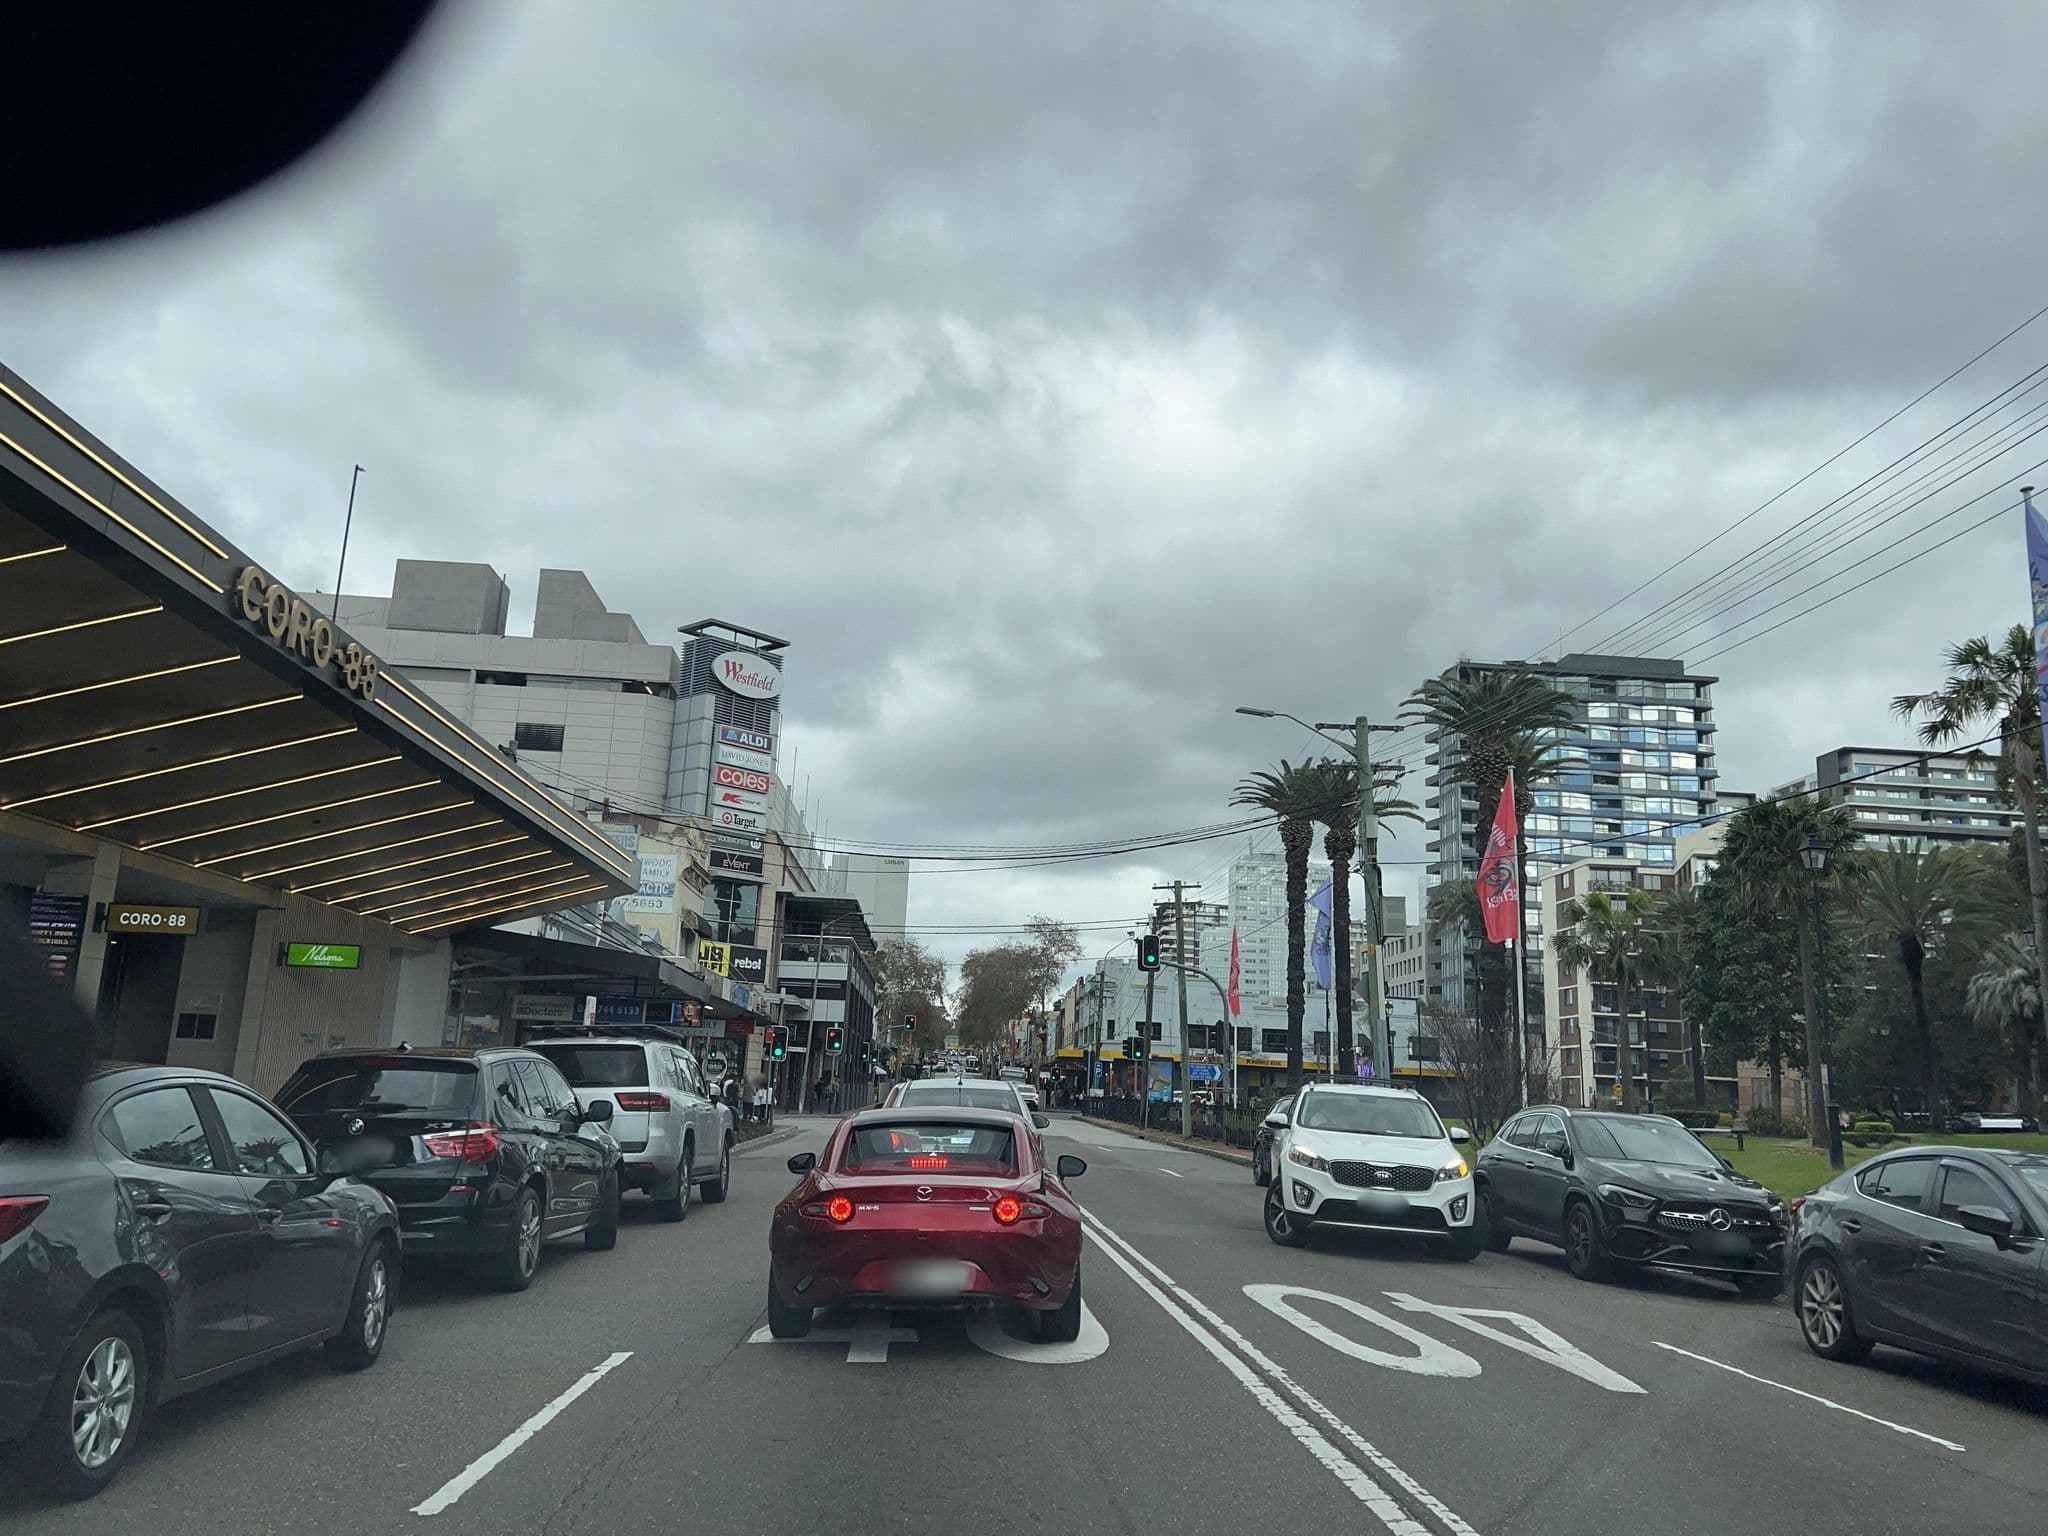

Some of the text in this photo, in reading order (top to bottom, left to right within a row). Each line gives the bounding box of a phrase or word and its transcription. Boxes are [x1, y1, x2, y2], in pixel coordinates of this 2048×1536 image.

[724, 660, 776, 691] Westfield
[739, 732, 768, 749] ALDI
[721, 750, 768, 768] DAVID JONES
[720, 768, 767, 790] coles
[631, 898, 664, 909] 5653
[699, 945, 724, 960] JB
[735, 957, 762, 971] rebel
[616, 1006, 640, 1015] 5133
